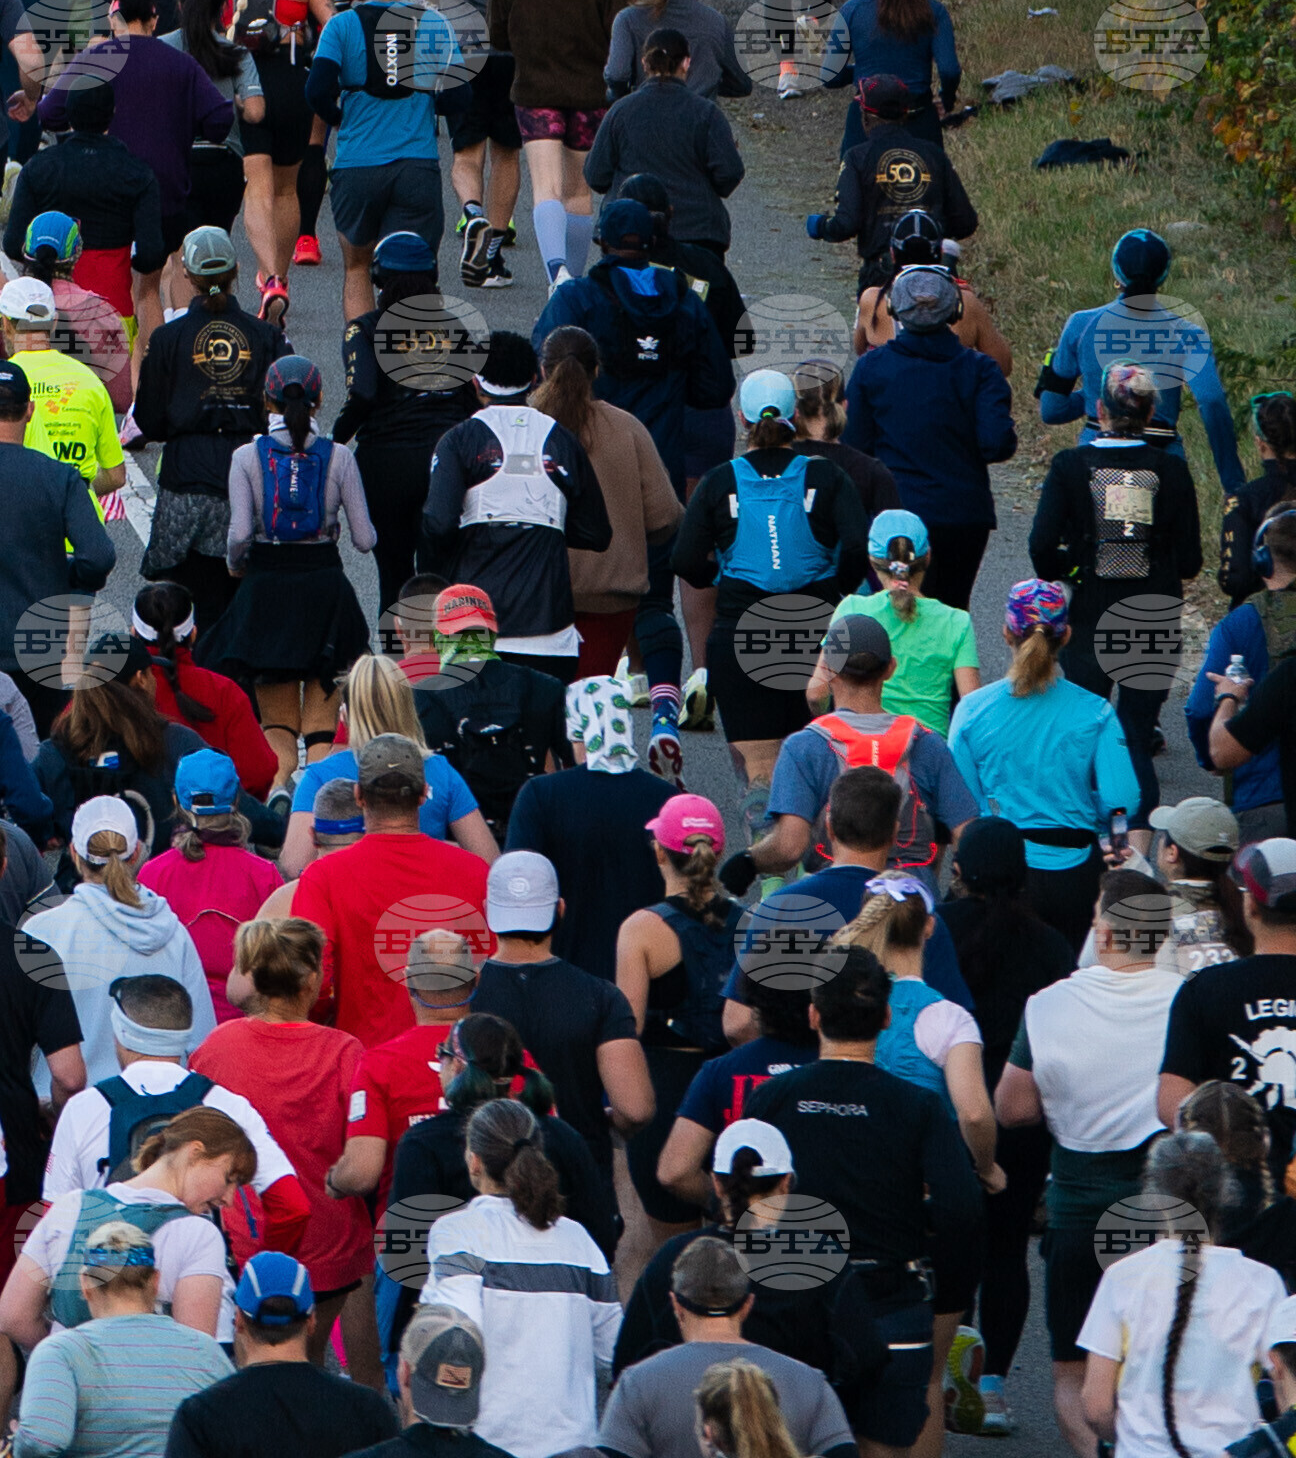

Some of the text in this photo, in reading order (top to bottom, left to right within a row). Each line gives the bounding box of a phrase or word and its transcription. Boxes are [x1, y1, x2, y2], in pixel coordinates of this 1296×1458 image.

[386, 33, 398, 86] INOXTO
[889, 163, 915, 183] 50
[33, 382, 61, 395] illes
[768, 515, 781, 570] NATHAN
[444, 595, 489, 615] MARINES
[1230, 1057, 1247, 1079] 2
[797, 1100, 868, 1116] SEPHORA
